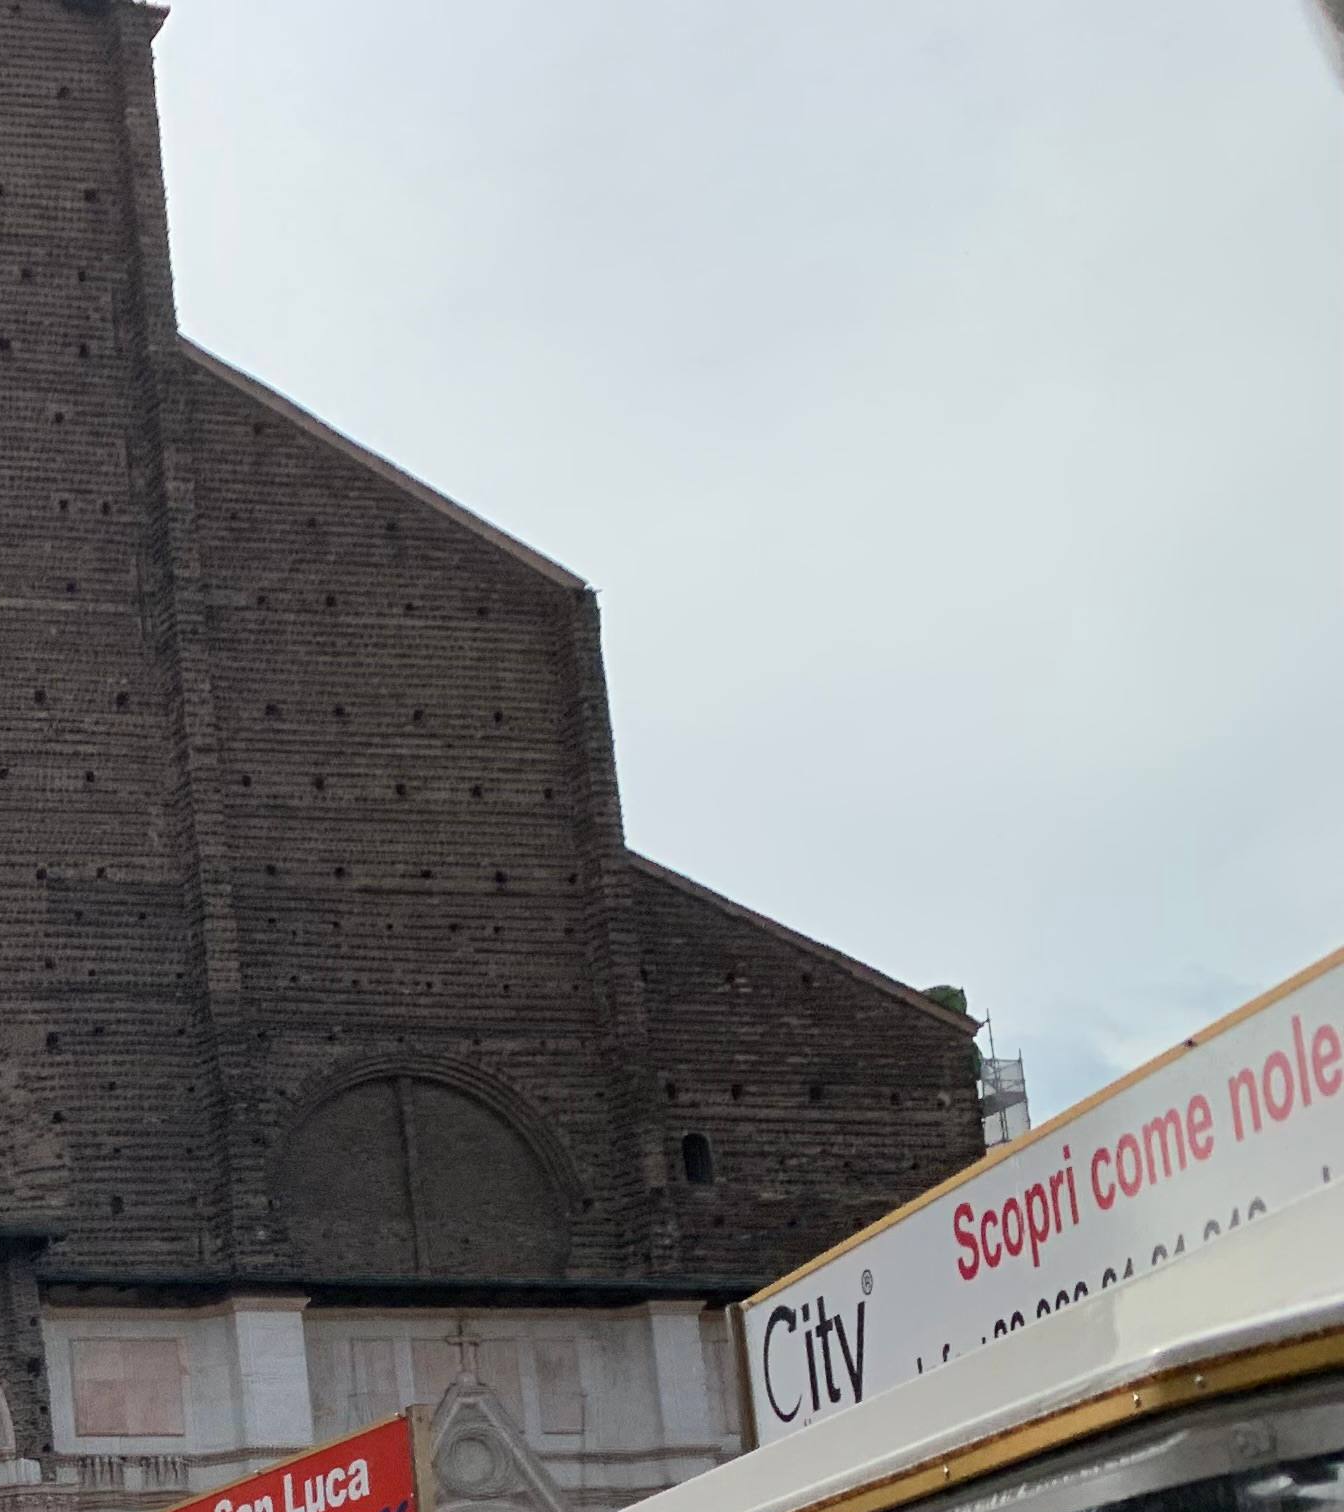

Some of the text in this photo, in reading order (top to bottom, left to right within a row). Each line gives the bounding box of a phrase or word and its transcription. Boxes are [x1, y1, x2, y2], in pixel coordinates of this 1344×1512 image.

[953, 1015, 1344, 1281] Scopri come nole
[763, 1295, 866, 1422] City
